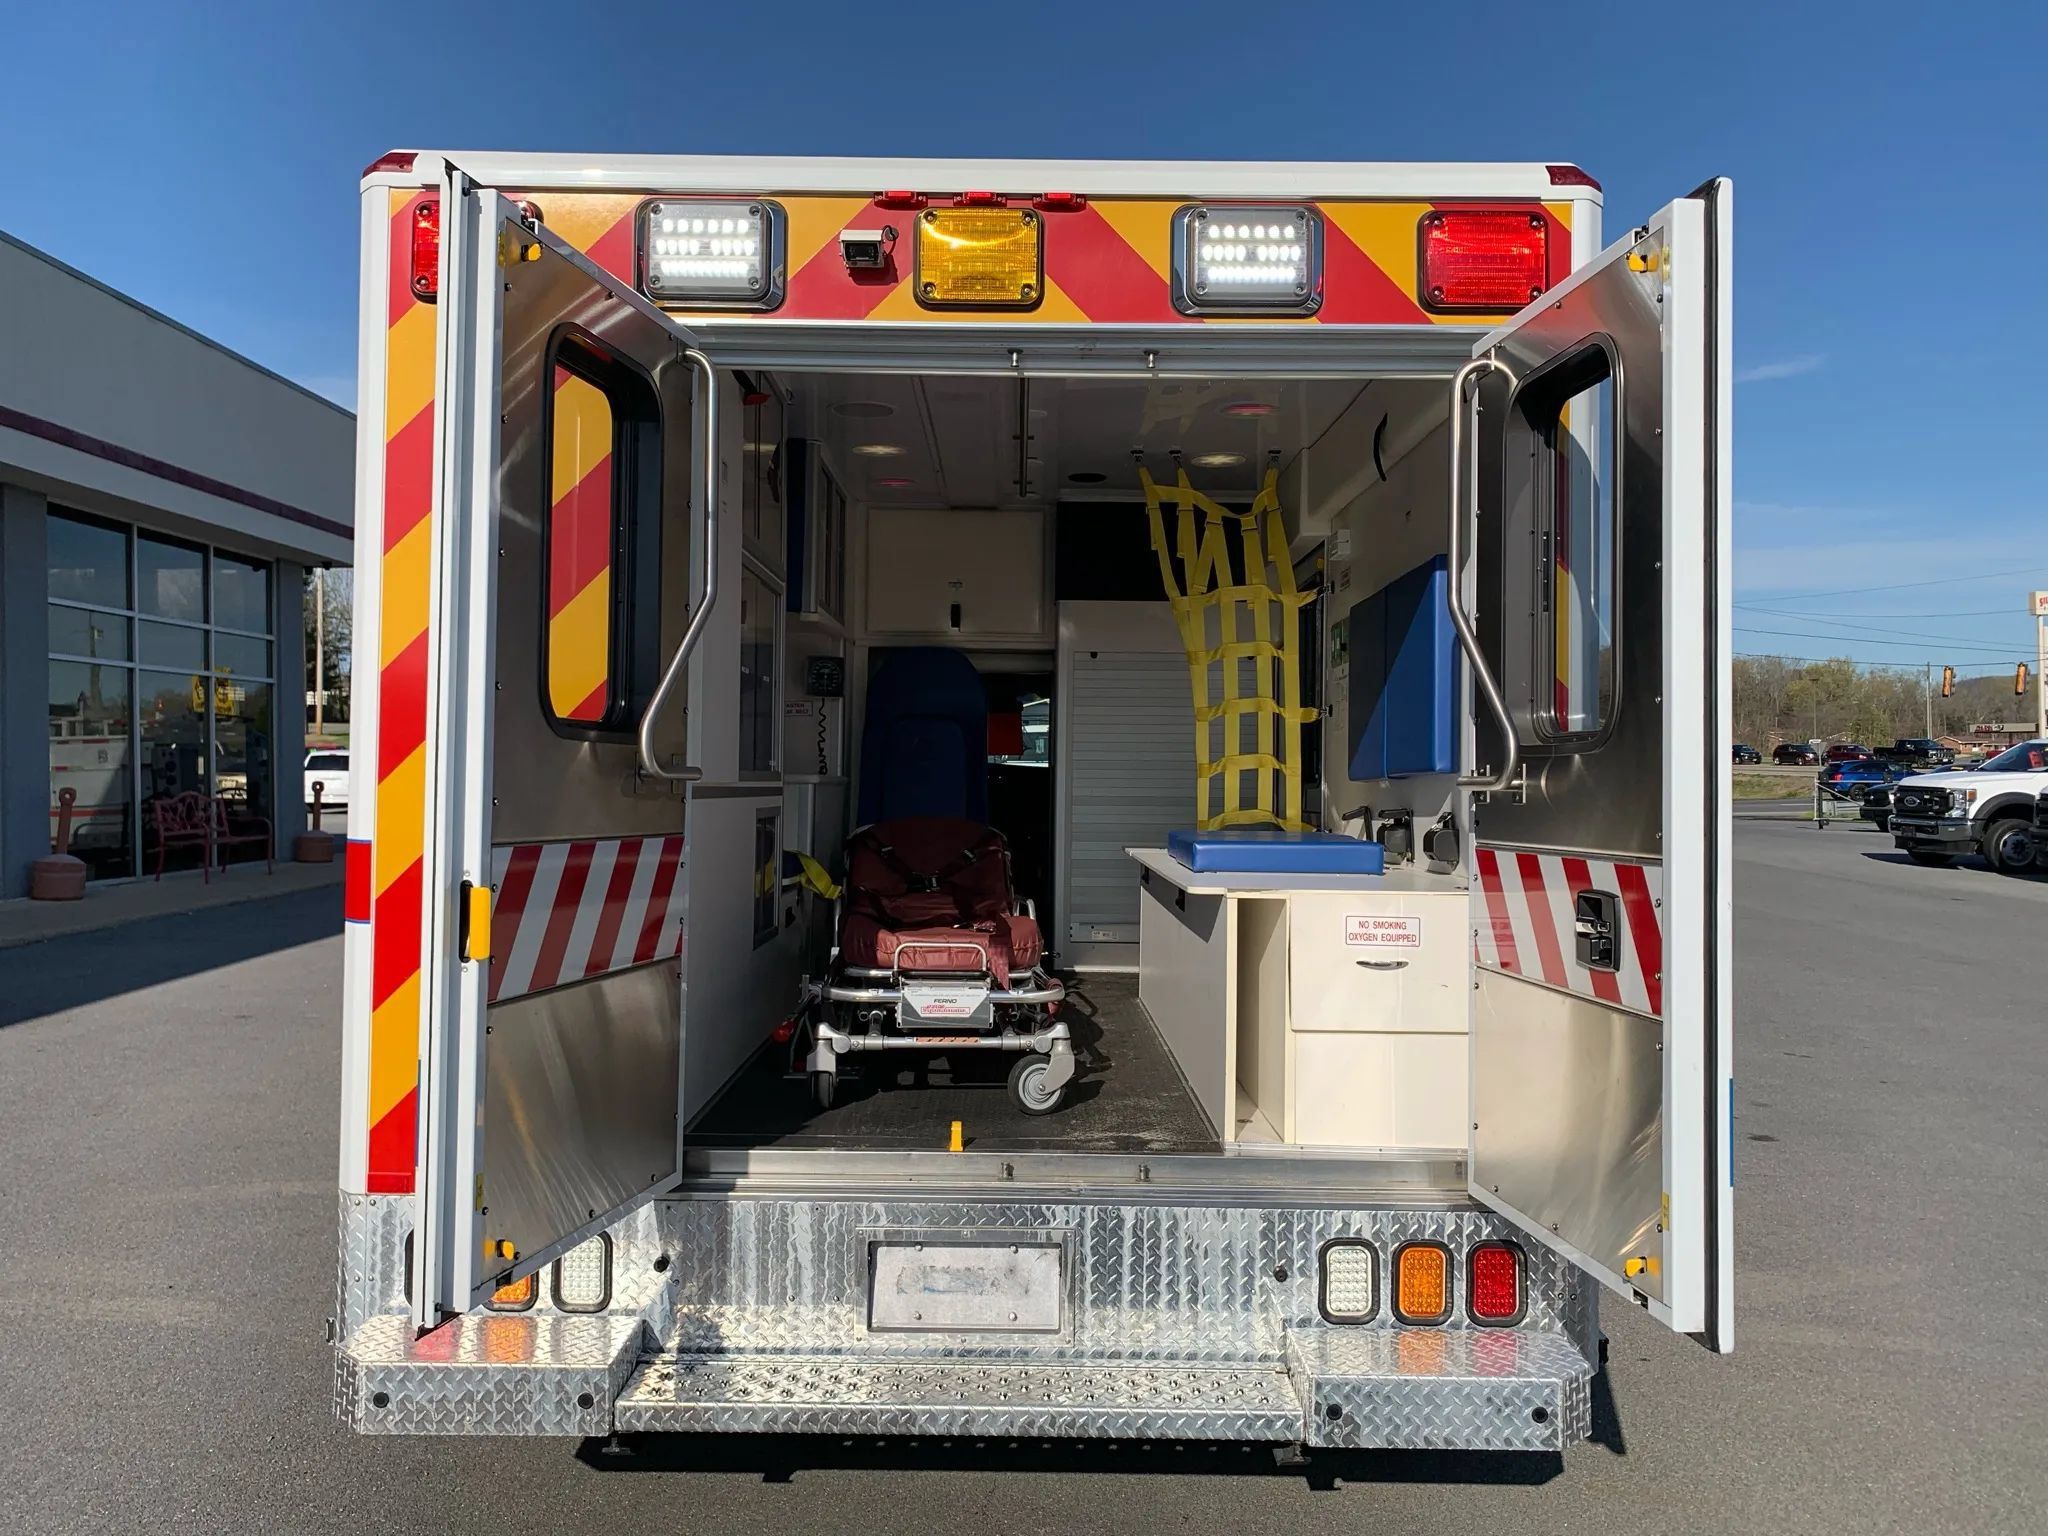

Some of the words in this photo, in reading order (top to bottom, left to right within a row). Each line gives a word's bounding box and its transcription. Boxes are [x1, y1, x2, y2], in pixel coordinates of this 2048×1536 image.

[1358, 920, 1370, 929] NO
[1372, 920, 1407, 930] SMOKING
[1348, 932, 1378, 942] OXYGEN
[1380, 933, 1417, 943] EQUIPPED
